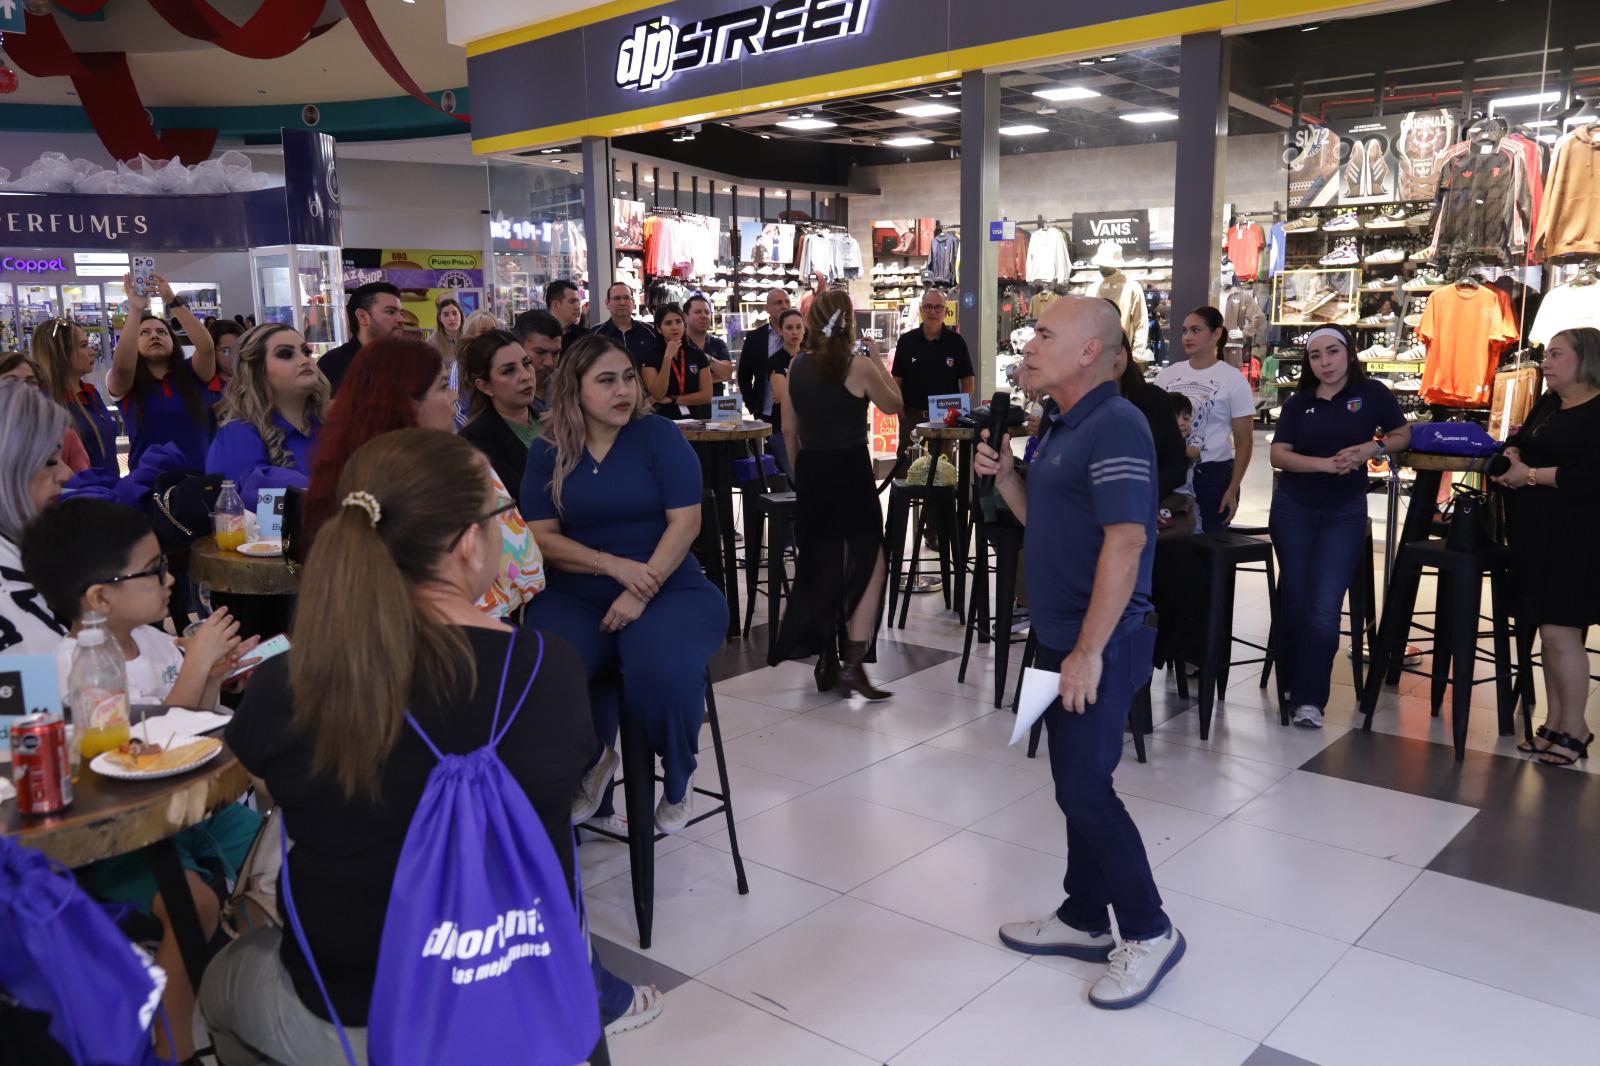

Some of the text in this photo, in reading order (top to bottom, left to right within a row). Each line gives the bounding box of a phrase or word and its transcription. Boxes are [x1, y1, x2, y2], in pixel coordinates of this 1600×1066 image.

[1401, 114, 1454, 129] ORIGINALS
[0, 212, 148, 240] ERFUMES
[1090, 218, 1132, 236] VANS
[2, 256, 68, 274] Coppel
[391, 252, 408, 261] BBQ
[359, 270, 383, 287] SHOP
